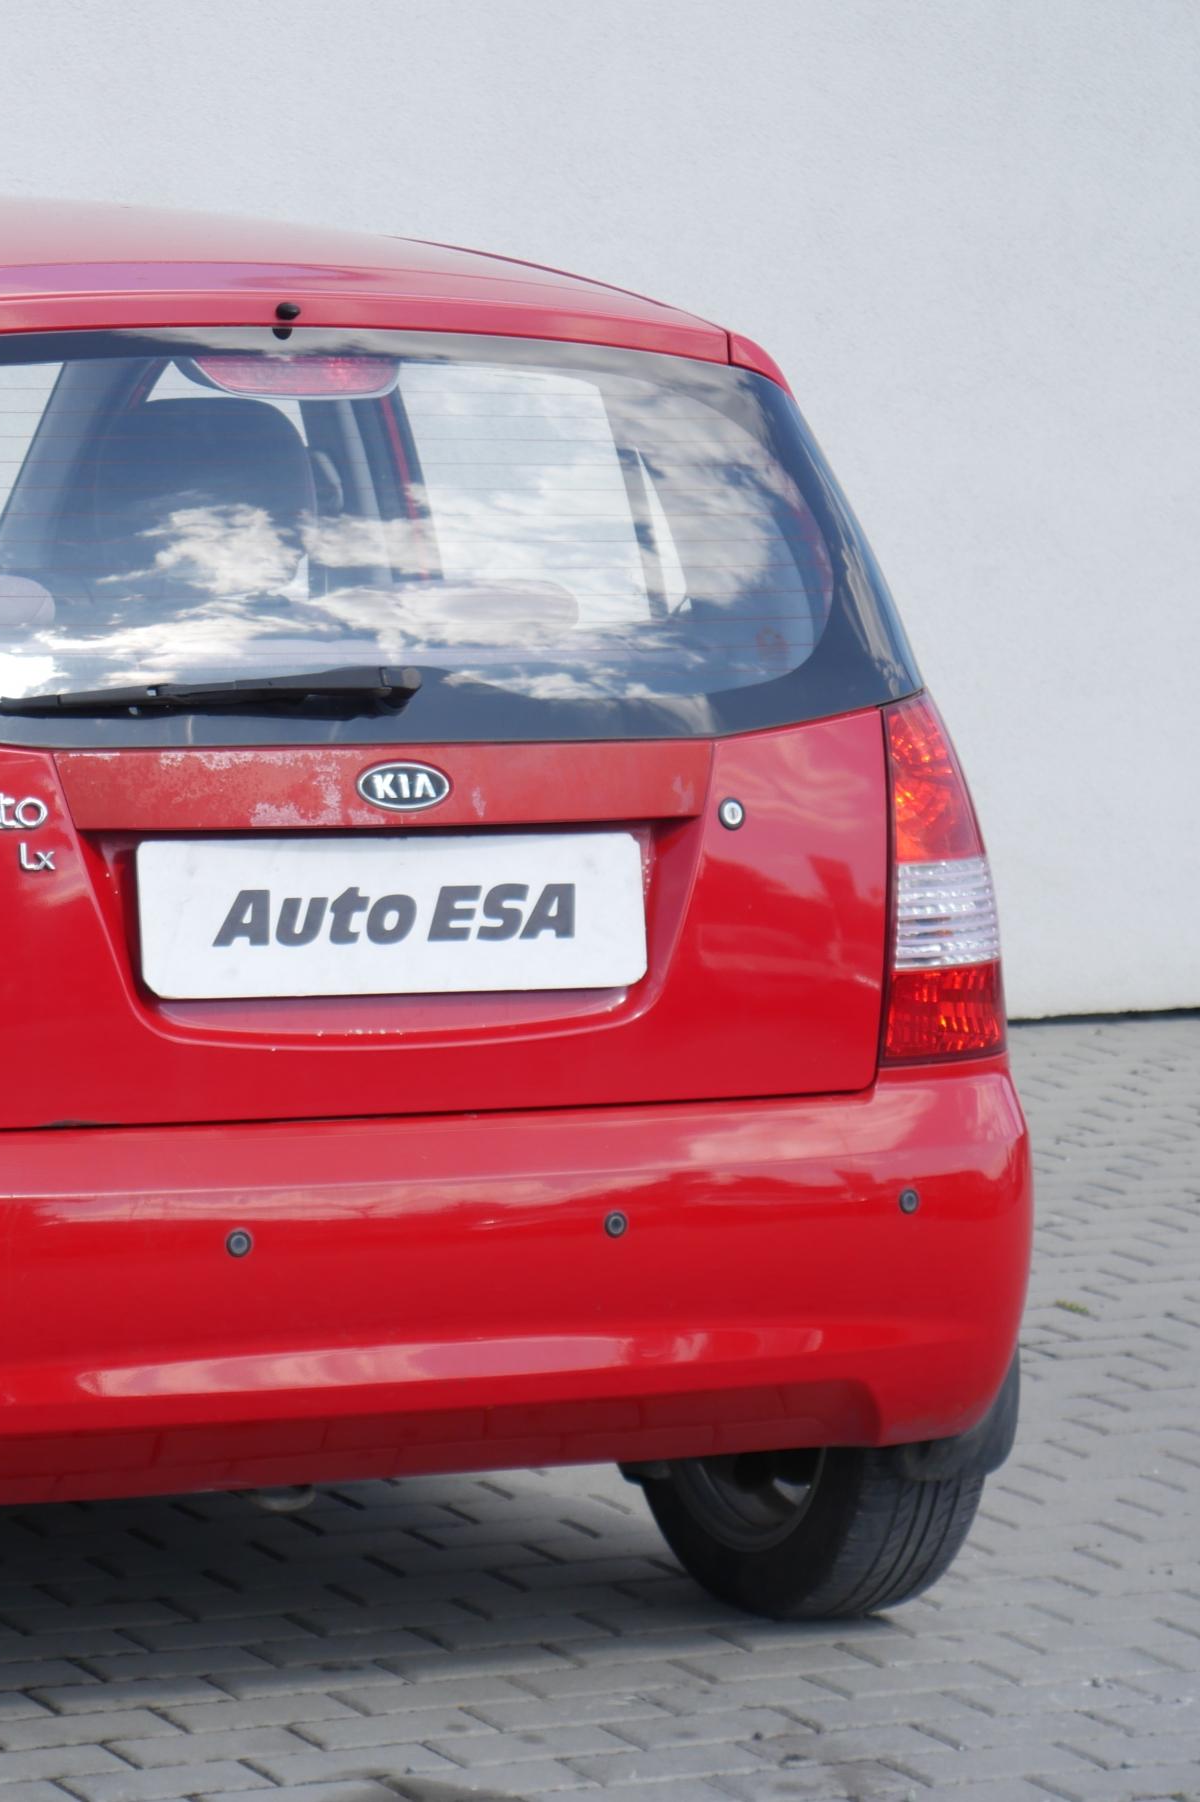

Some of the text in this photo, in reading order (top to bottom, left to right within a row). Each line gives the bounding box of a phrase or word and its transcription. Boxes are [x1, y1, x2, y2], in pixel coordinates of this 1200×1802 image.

[372, 772, 437, 799] KIA
[212, 883, 575, 947] Auto ESA
